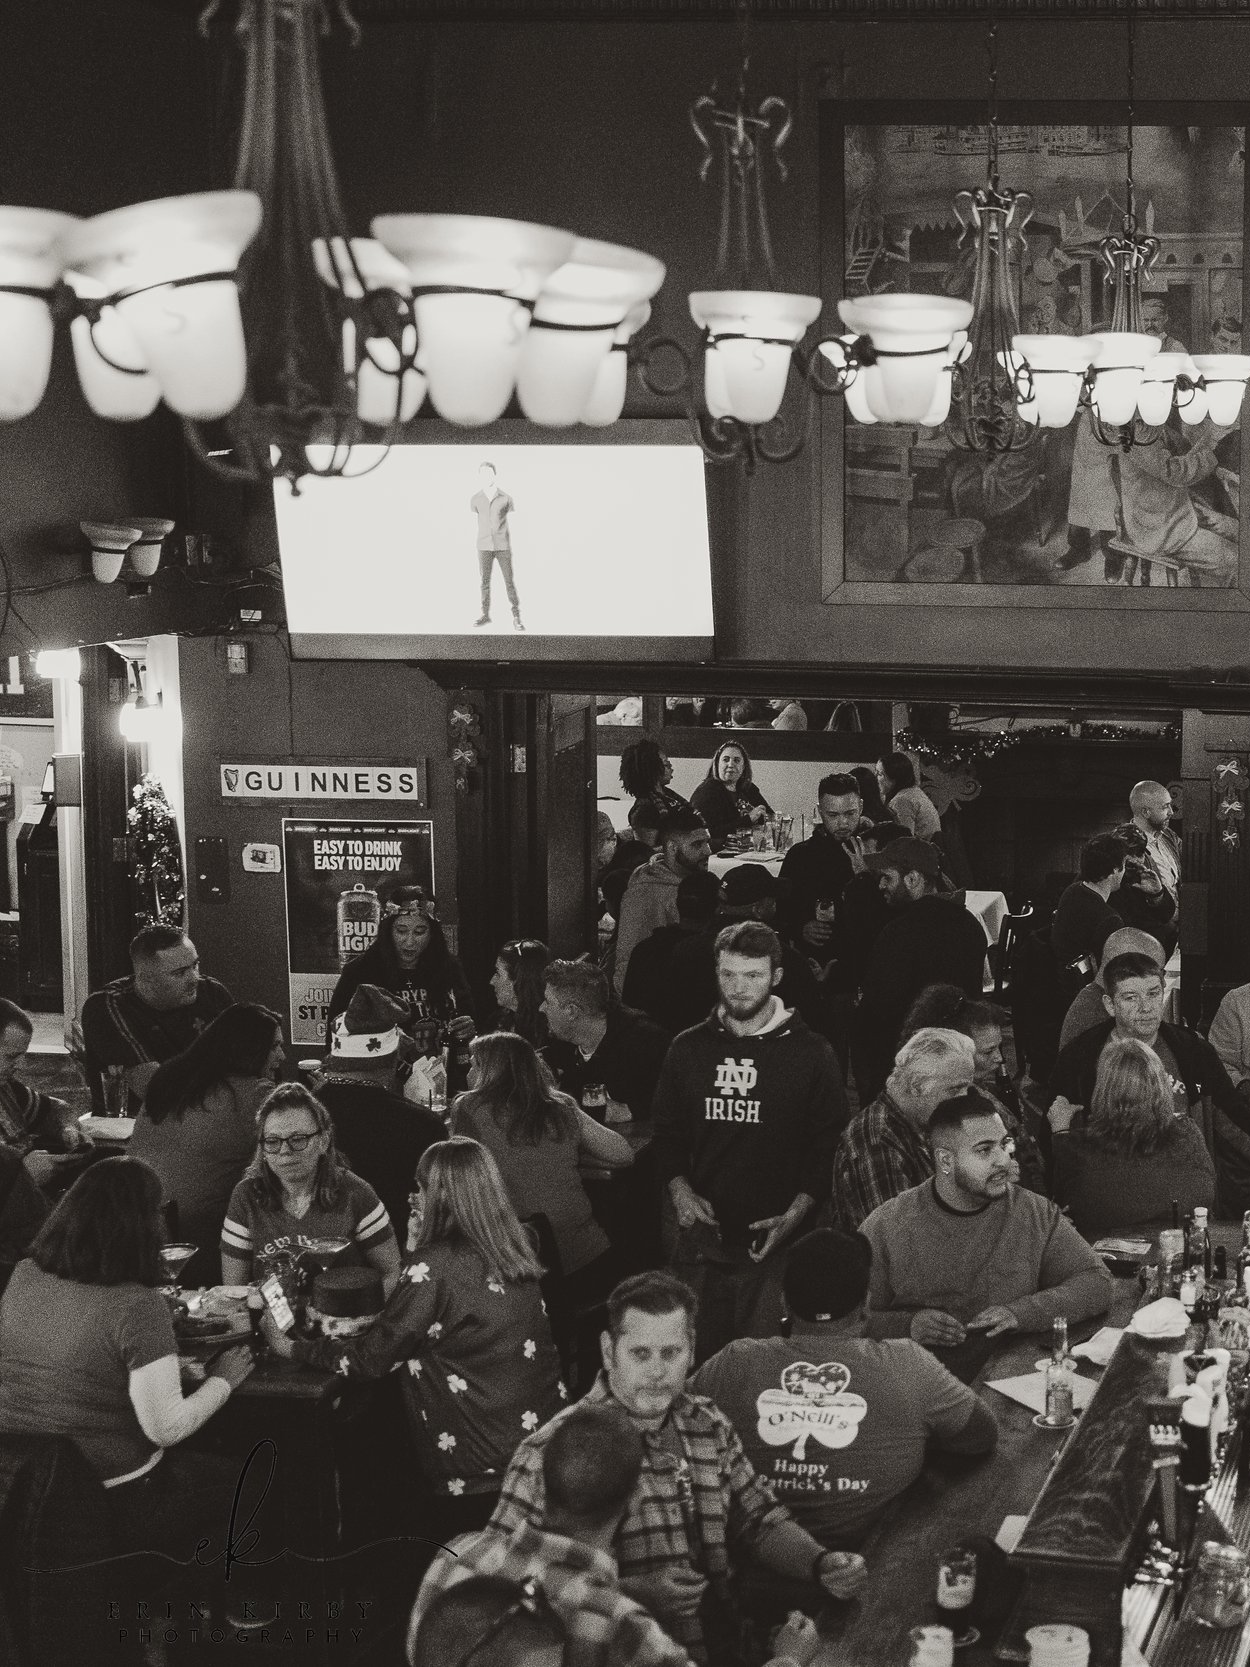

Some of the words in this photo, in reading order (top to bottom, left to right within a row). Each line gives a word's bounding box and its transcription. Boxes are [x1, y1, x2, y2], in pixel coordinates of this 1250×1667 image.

[244, 770, 414, 794] GUINNESS
[313, 839, 345, 855] EASY
[346, 840, 363, 855] TO
[365, 840, 403, 856] DRINK
[314, 855, 346, 870] EASY
[346, 856, 362, 870] TO
[364, 856, 402, 871] ENJOY
[342, 921, 379, 937] BUD
[339, 936, 374, 951] LIGH
[298, 1004, 318, 1020] ST
[704, 1097, 762, 1123] IRISH
[774, 1459, 829, 1477] Happy
[838, 1477, 870, 1493] Day
